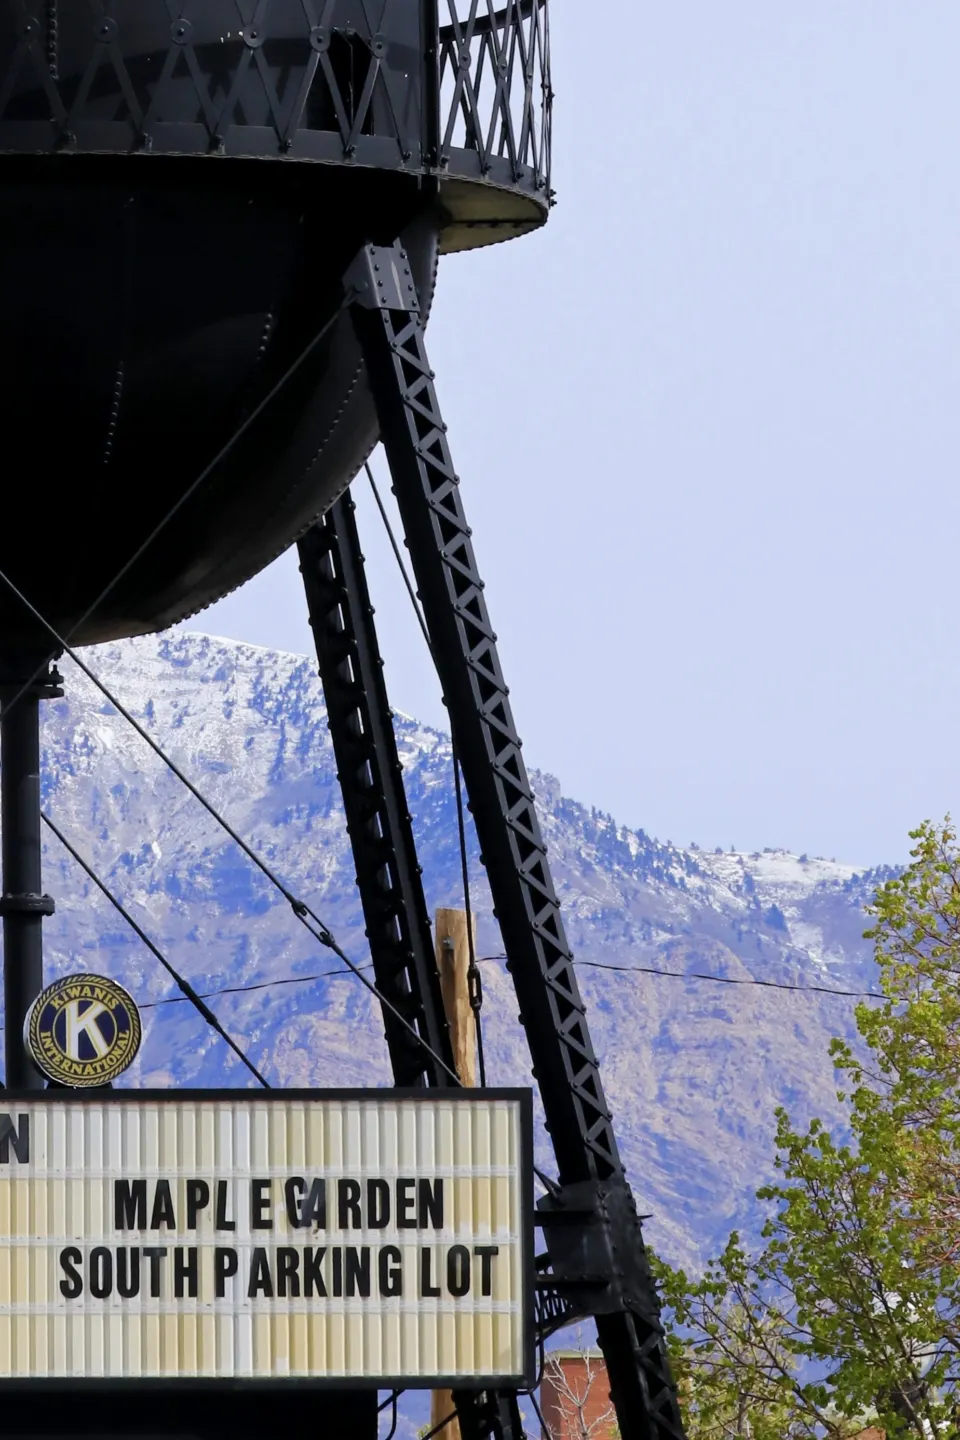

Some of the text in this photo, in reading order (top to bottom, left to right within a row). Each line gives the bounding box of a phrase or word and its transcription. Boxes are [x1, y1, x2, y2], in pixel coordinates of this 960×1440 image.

[50, 986, 119, 1010] KIWANIS
[40, 1030, 130, 1076] INTERNATIONAL
[64, 999, 111, 1060] K
[114, 1176, 444, 1231] MAPLE GARDEN
[58, 1245, 499, 1300] SOUTH PARKING LOT
